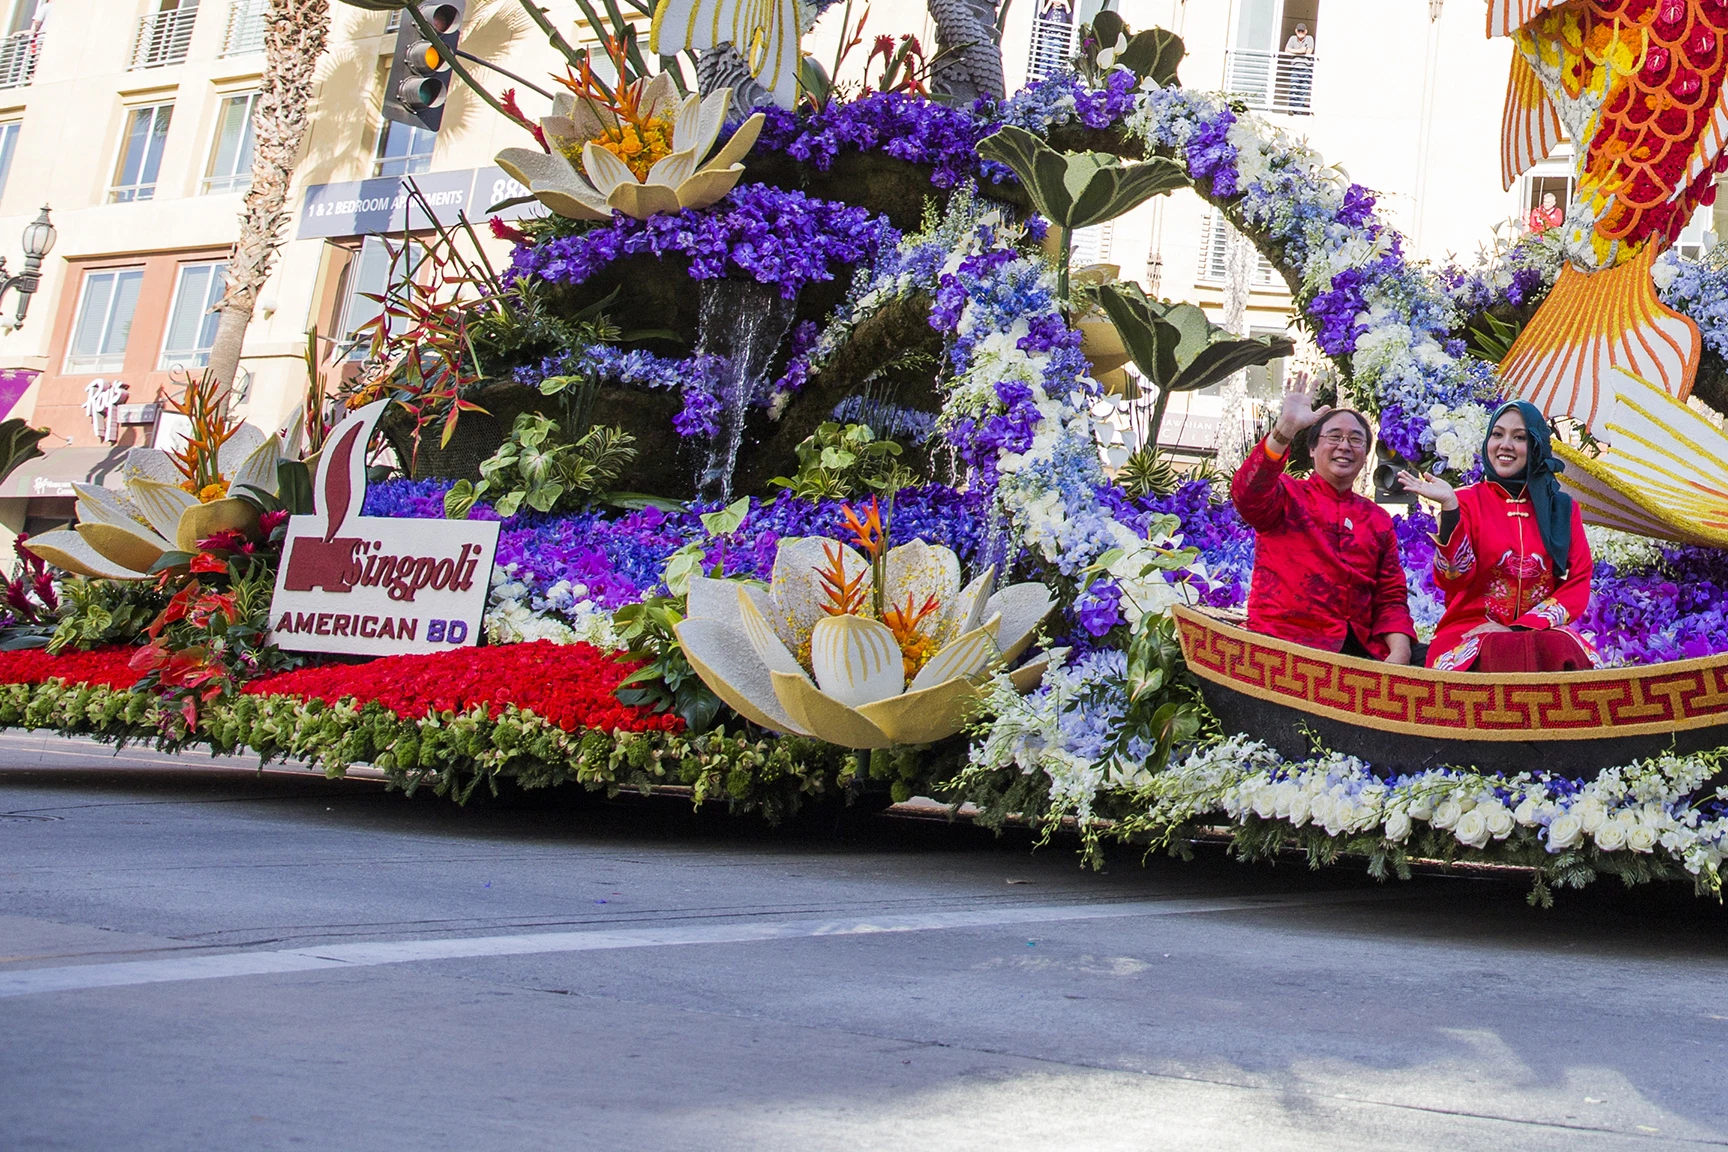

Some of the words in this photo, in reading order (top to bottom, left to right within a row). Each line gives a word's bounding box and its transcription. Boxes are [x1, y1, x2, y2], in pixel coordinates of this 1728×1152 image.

[308, 204, 314, 217] 1
[316, 203, 325, 216] &
[326, 202, 334, 216] 2
[335, 197, 389, 215] BEDROOM
[339, 540, 482, 601] Singpoli
[275, 611, 418, 641] AMERICAN
[426, 619, 468, 644] BD
